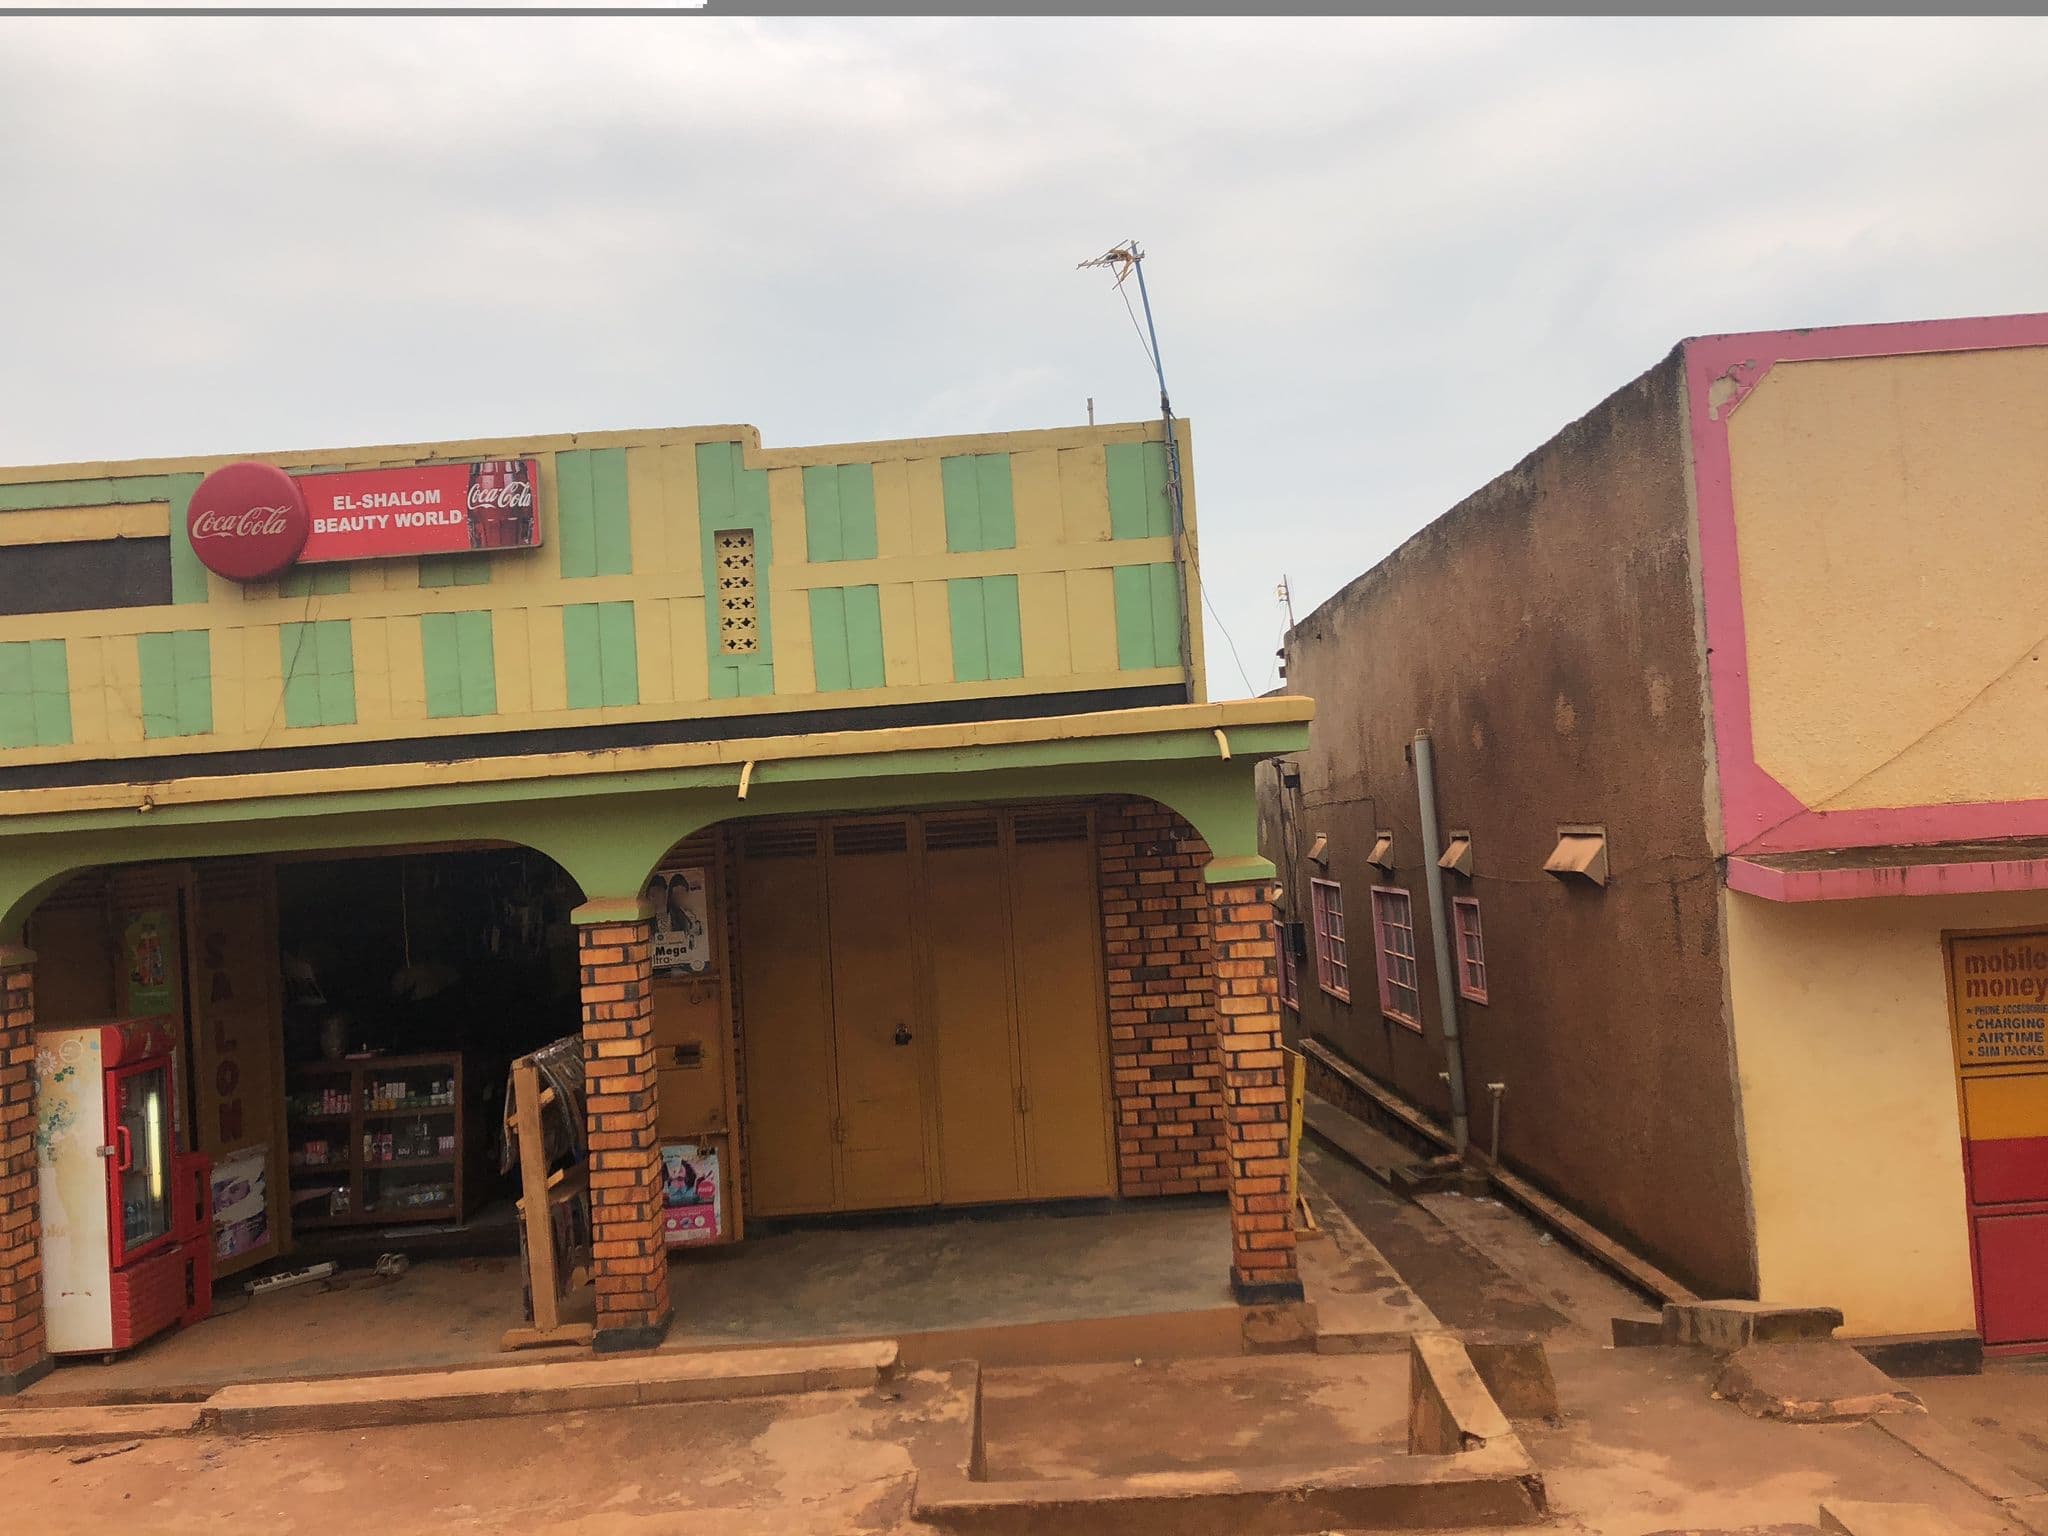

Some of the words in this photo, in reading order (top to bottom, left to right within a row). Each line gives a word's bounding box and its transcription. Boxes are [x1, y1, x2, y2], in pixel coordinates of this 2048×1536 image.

[332, 489, 442, 512] EL-SHALOM
[467, 481, 532, 510] Coca-Cola
[192, 504, 294, 539] Coca-Cola
[313, 514, 388, 534] BEAUTY
[395, 509, 463, 527] WORLD
[655, 946, 687, 957] Mega
[1965, 945, 2048, 974] mobile
[1966, 976, 2048, 1003] money
[1975, 1017, 2046, 1029] CHARGING
[1977, 1032, 2044, 1044] AIRTIME
[1977, 1046, 2000, 1057] SIM
[2004, 1045, 2045, 1057] PACKS
